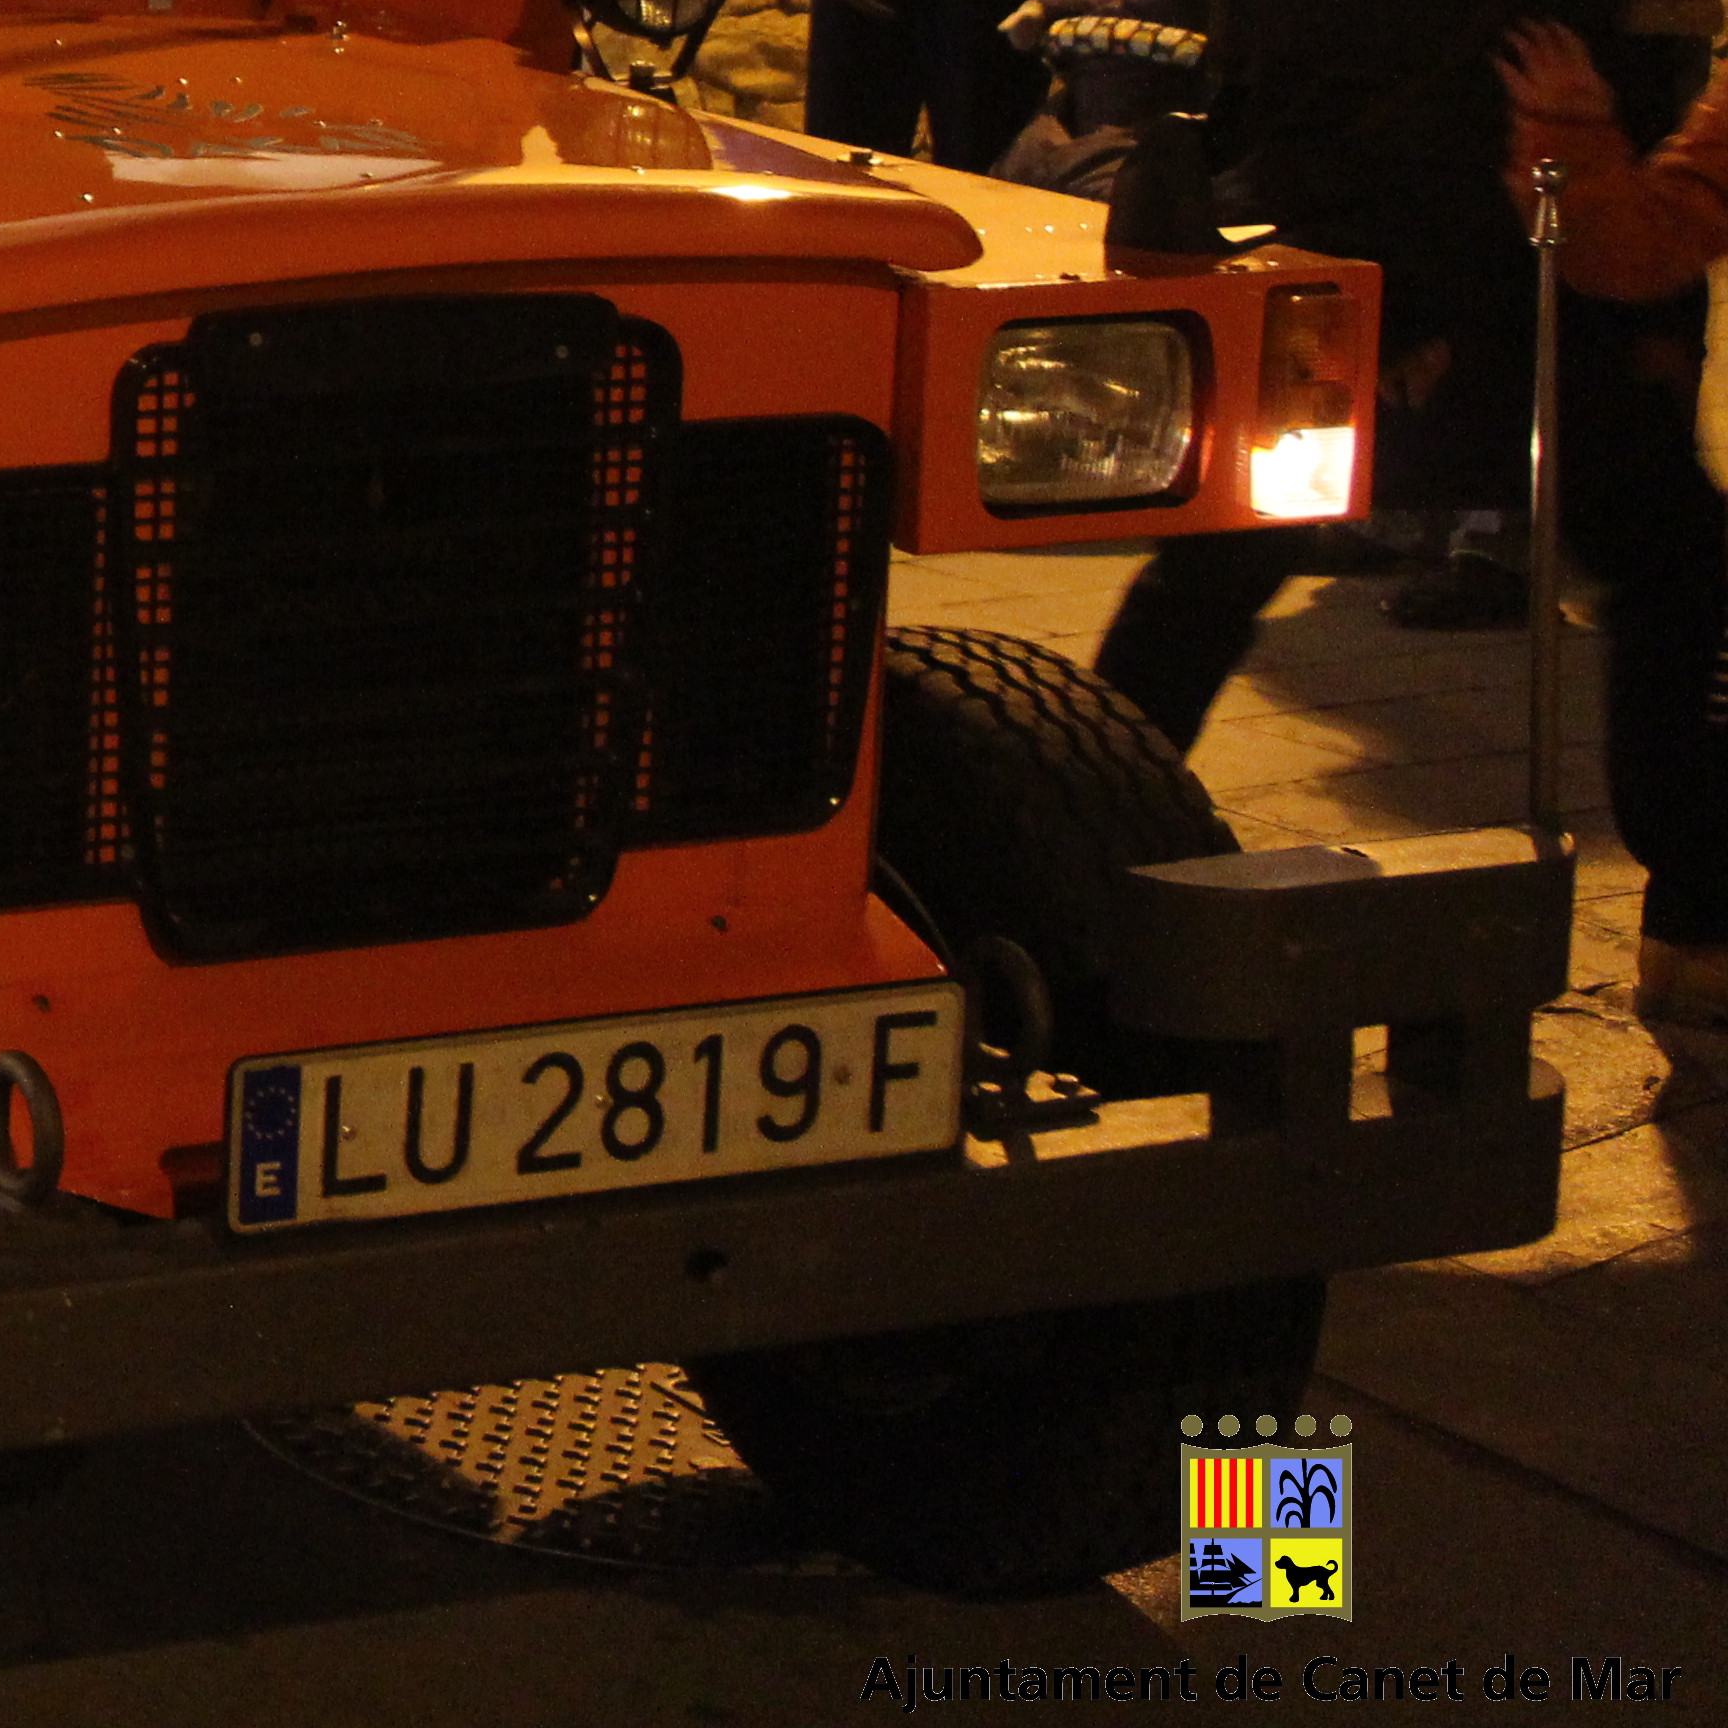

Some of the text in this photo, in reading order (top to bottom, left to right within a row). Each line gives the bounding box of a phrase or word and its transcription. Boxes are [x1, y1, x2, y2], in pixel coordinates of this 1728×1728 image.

[515, 1023, 823, 1177] 2819
[867, 1010, 938, 1135] F
[252, 1161, 283, 1199] E
